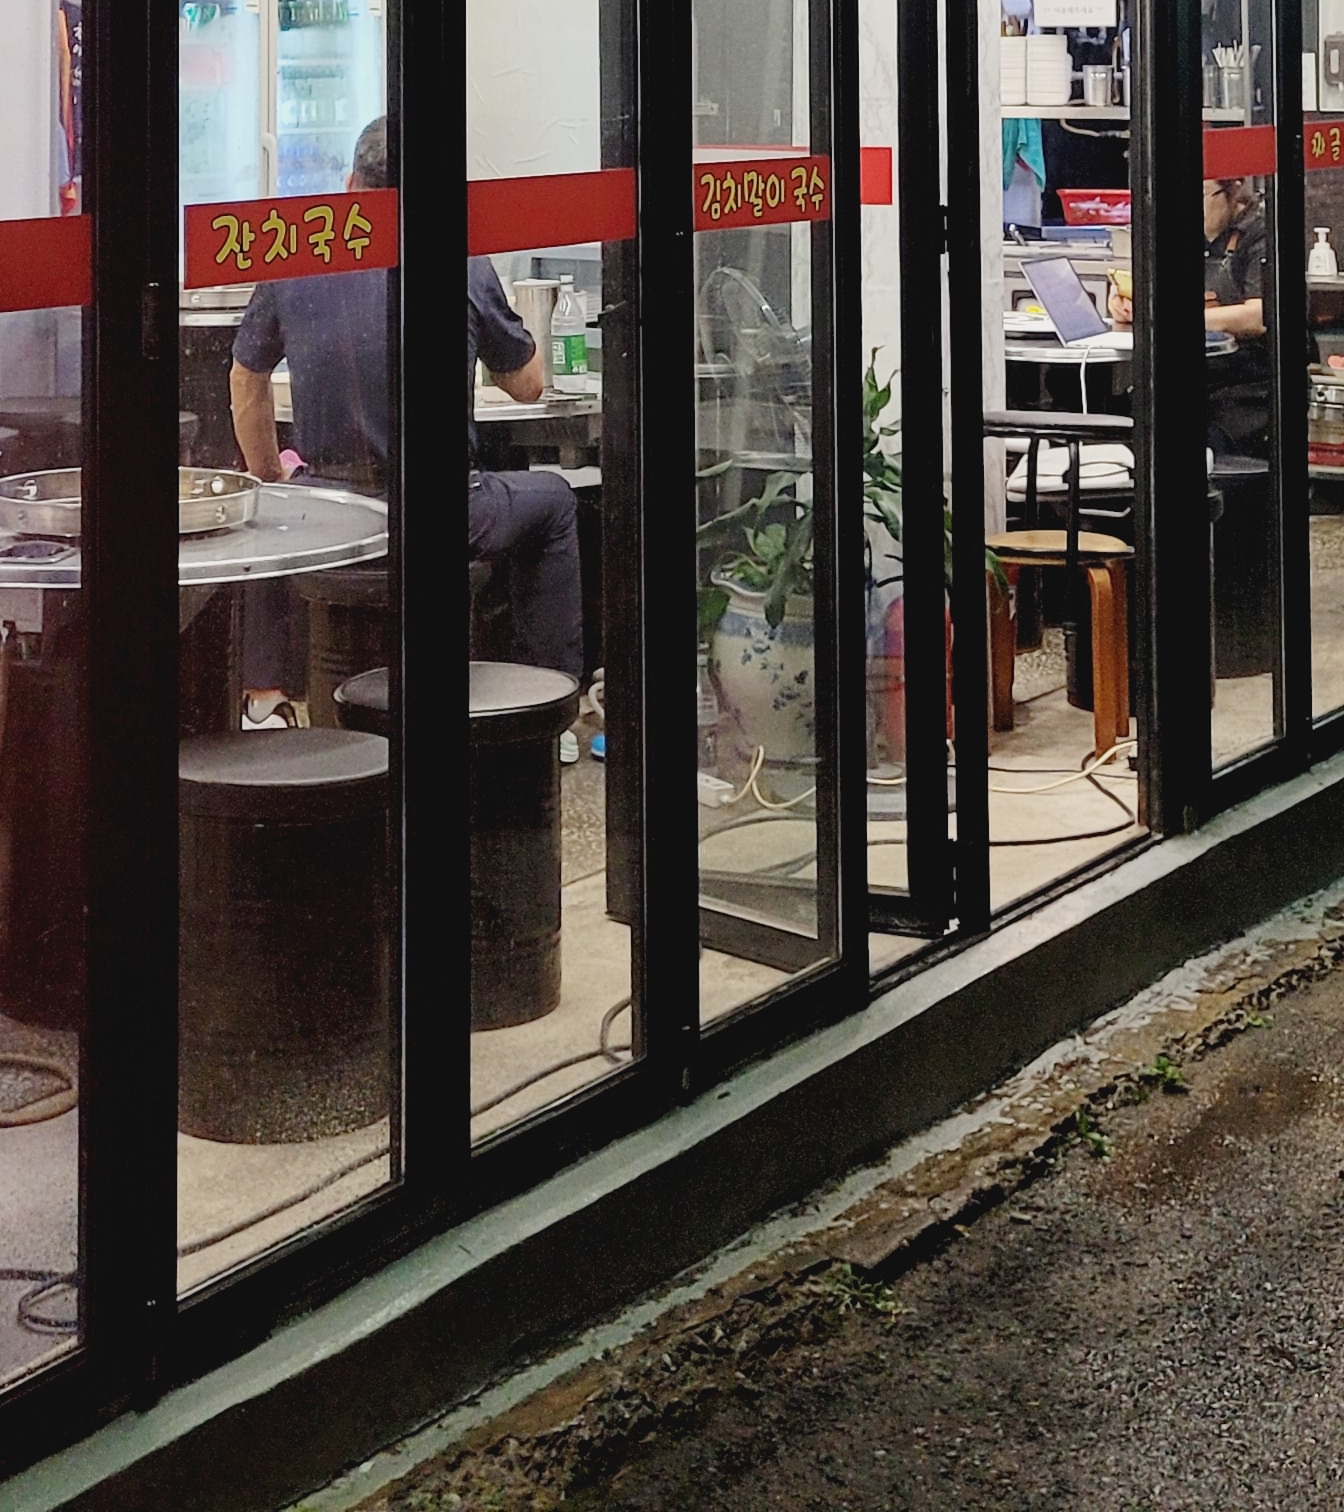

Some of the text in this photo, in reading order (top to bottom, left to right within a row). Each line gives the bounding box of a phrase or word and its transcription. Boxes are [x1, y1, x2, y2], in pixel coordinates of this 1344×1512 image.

[700, 165, 825, 221] 김치말이 국수
[211, 202, 373, 270] 잔치국수
